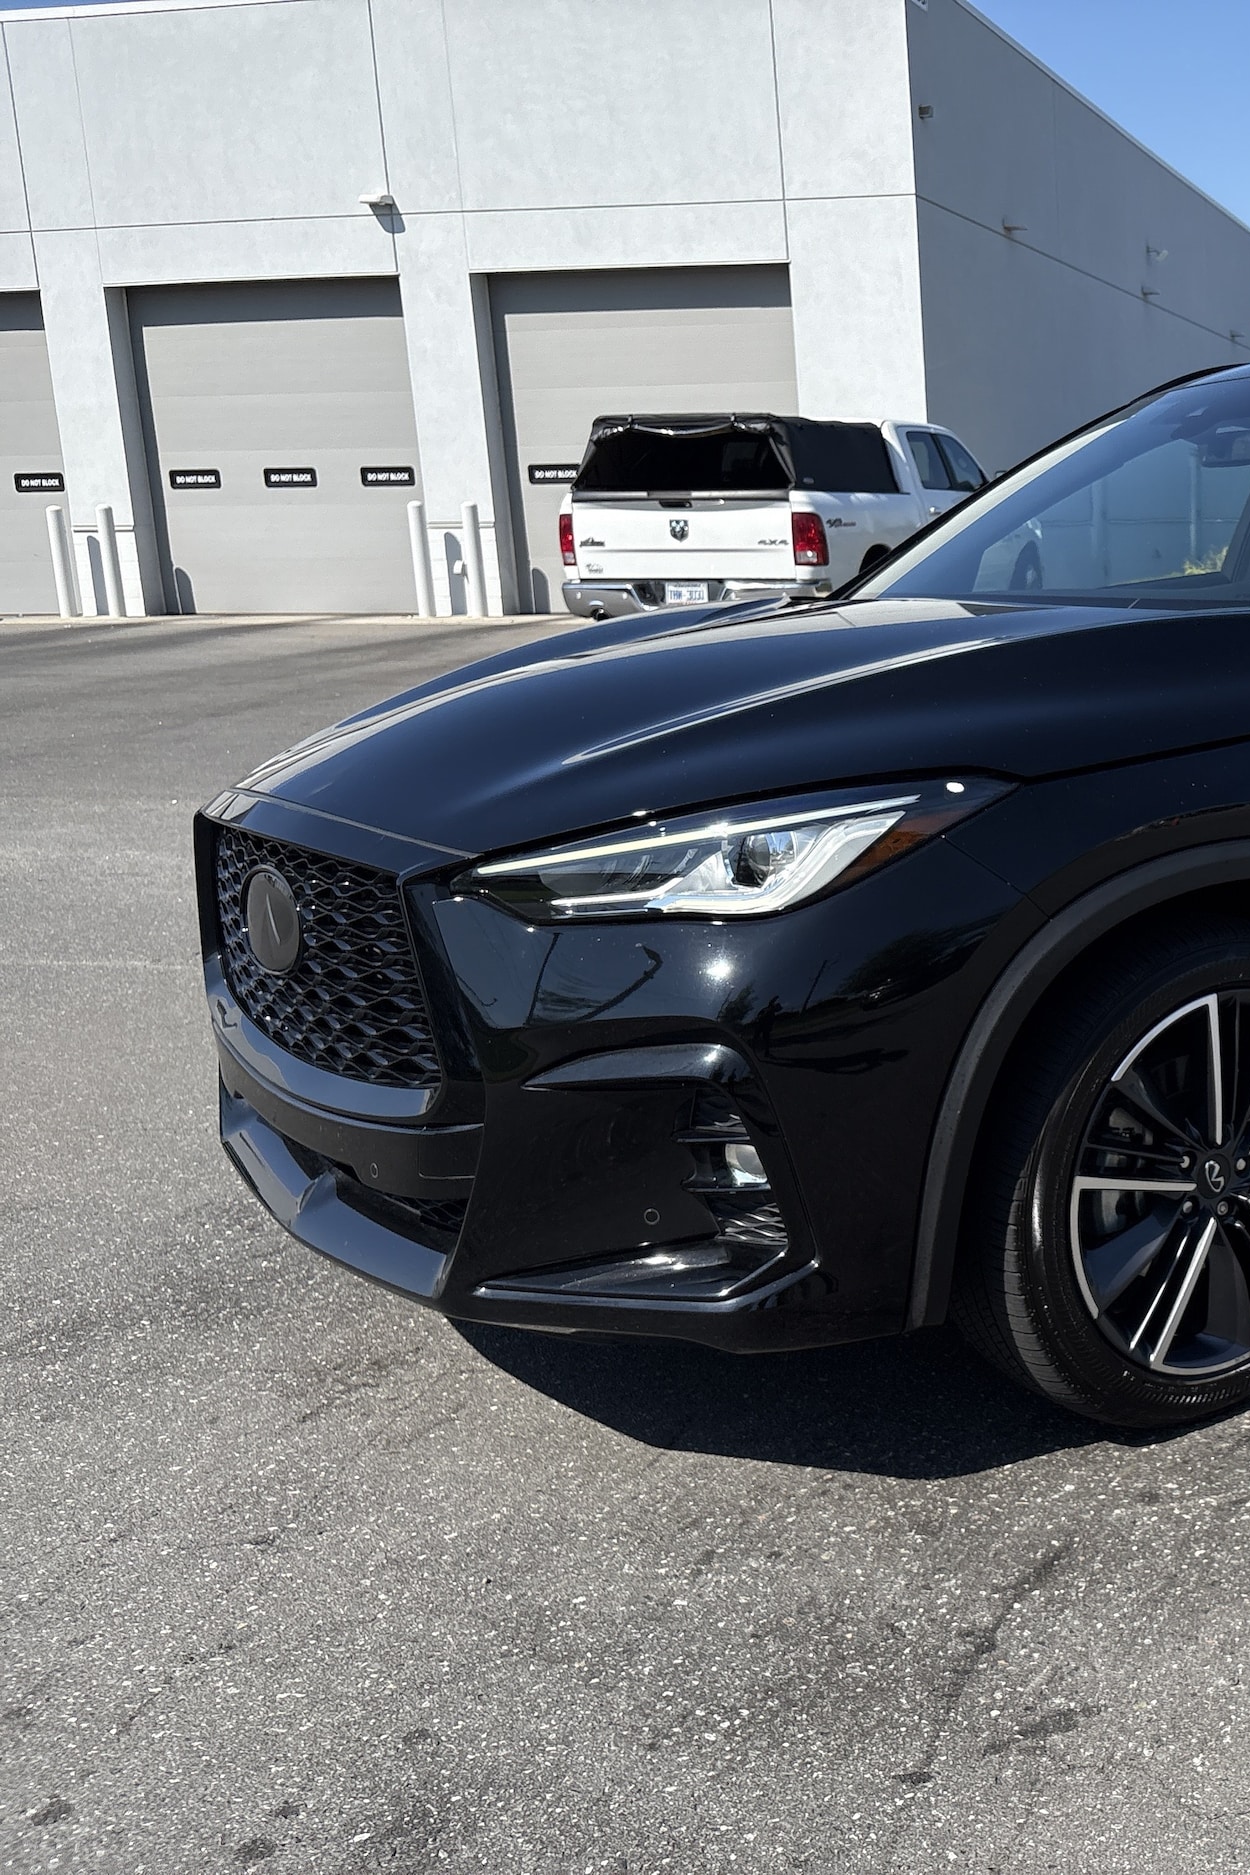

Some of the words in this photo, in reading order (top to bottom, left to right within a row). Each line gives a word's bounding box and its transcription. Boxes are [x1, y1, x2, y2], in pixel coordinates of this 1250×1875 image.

[270, 474, 280, 482] DO
[280, 473, 292, 481] NOT
[293, 473, 312, 482] BLOCK
[367, 472, 377, 481] DO
[377, 472, 389, 480] NOT
[390, 472, 409, 481] BLOCK
[535, 470, 545, 478] DO
[545, 470, 557, 478] NOT
[21, 479, 30, 487] DO
[30, 479, 41, 487] NOT
[42, 478, 60, 486] BLOCK
[176, 475, 185, 484] DO
[185, 475, 197, 483] NOT
[198, 475, 216, 483] BLOCK
